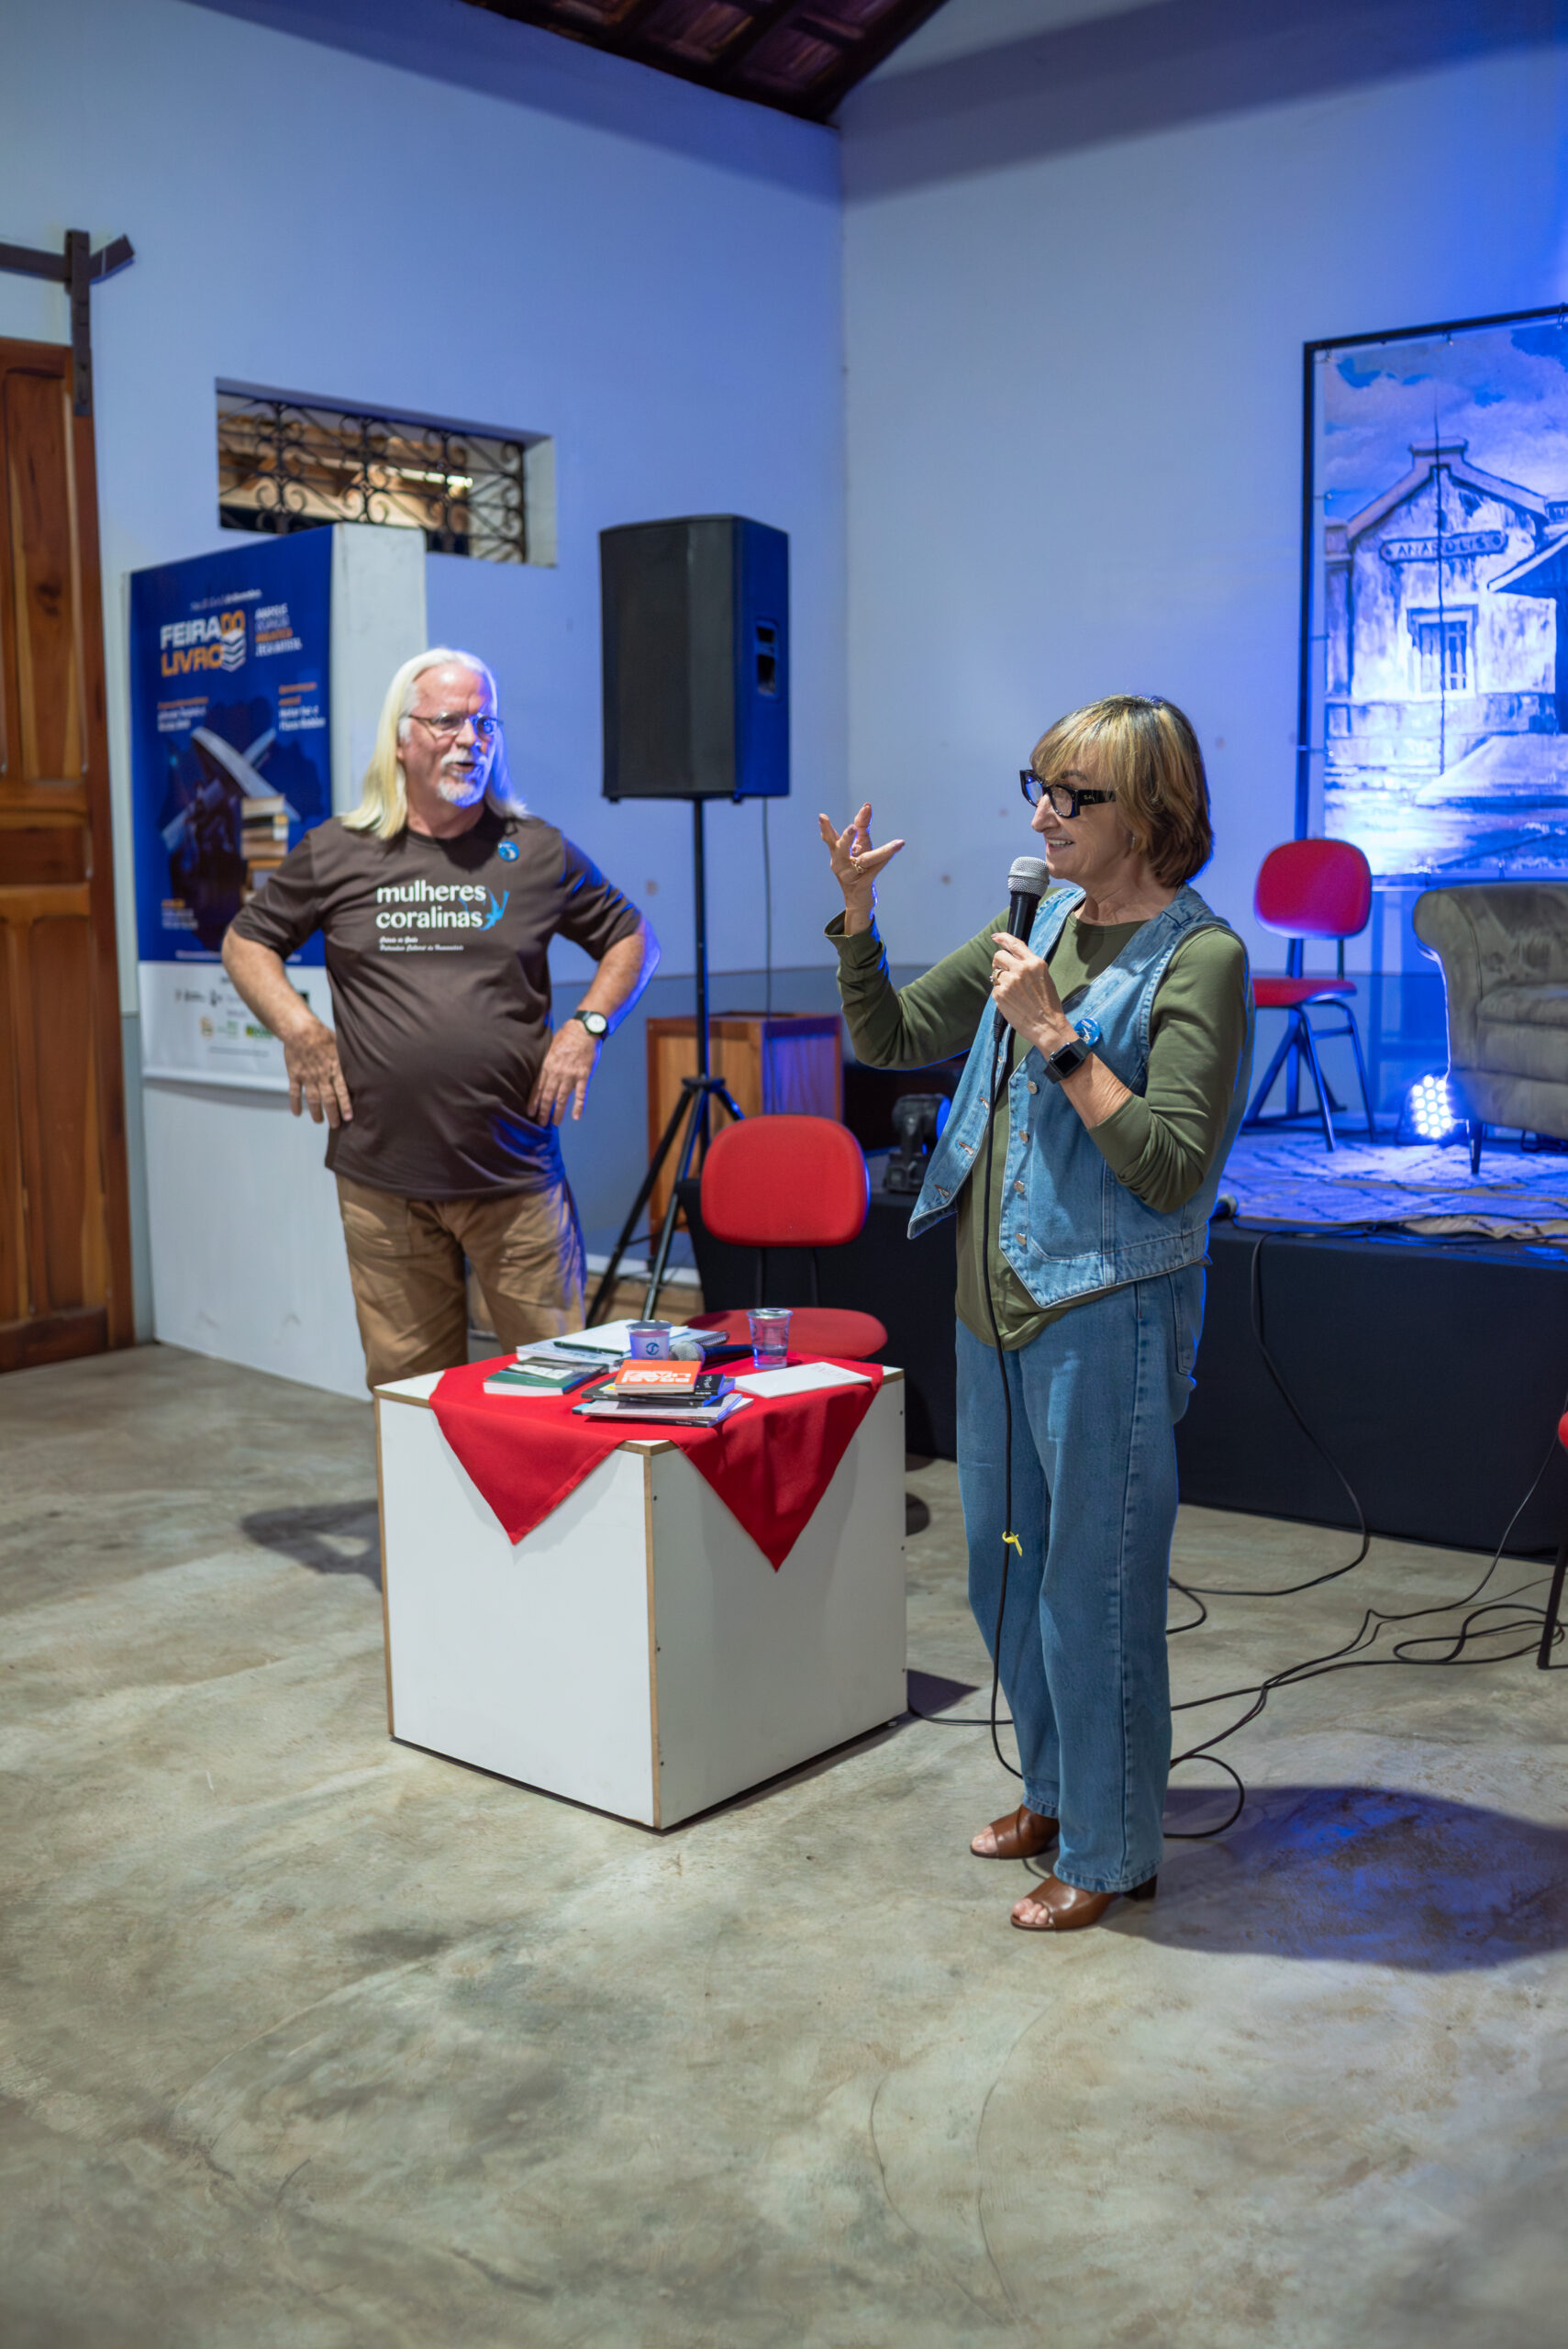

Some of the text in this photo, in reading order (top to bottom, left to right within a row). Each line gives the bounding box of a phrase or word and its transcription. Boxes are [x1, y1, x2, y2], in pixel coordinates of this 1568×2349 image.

[160, 616, 221, 651] FEIRA
[161, 643, 224, 677] LIVRO
[376, 879, 486, 903] mulheres
[375, 905, 484, 929] coralinas
